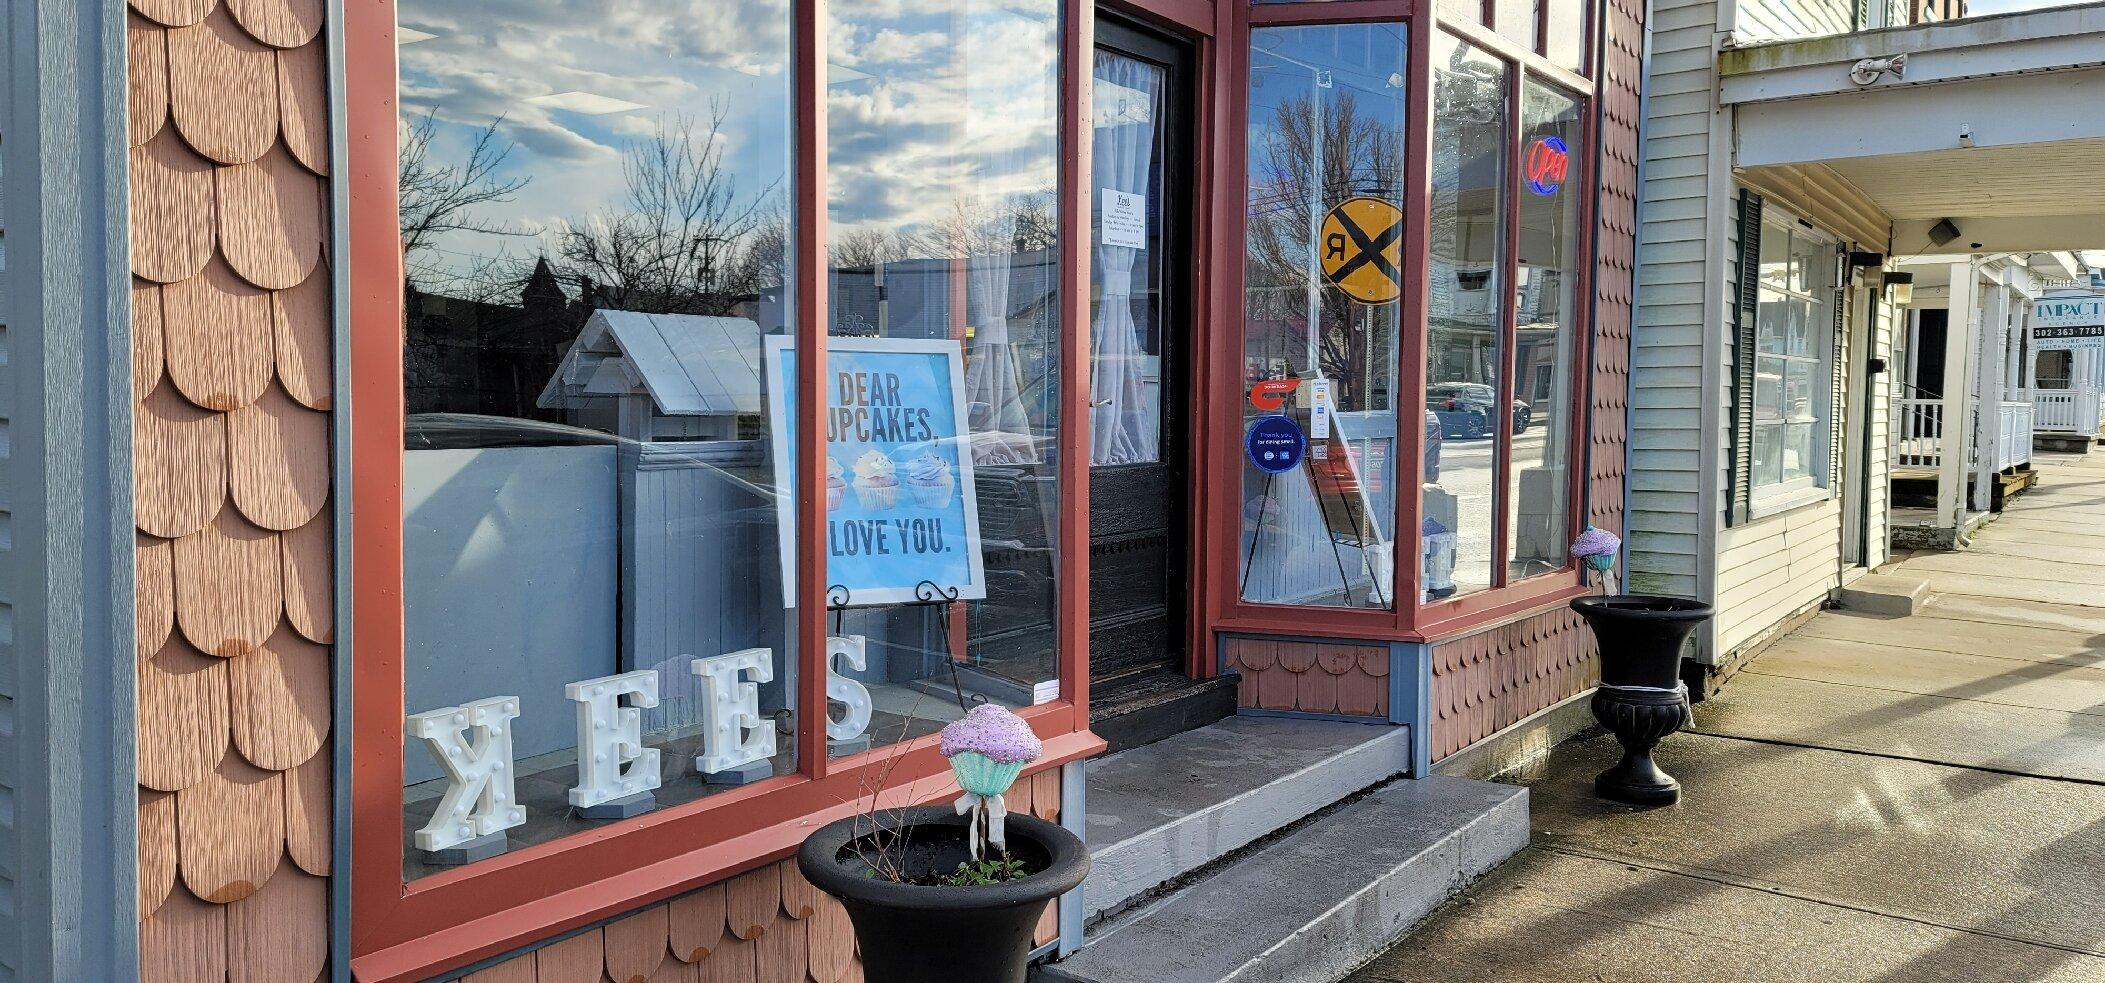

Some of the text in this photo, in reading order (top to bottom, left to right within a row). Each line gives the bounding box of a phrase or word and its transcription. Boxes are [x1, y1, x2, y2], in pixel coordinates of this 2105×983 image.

[2037, 302, 2103, 318] IMPACT
[2035, 327, 2103, 337] 302-363-7785
[838, 372, 902, 407] DEAR
[827, 407, 940, 448] UPCAKES,
[829, 517, 952, 557] LOVE YOU.
